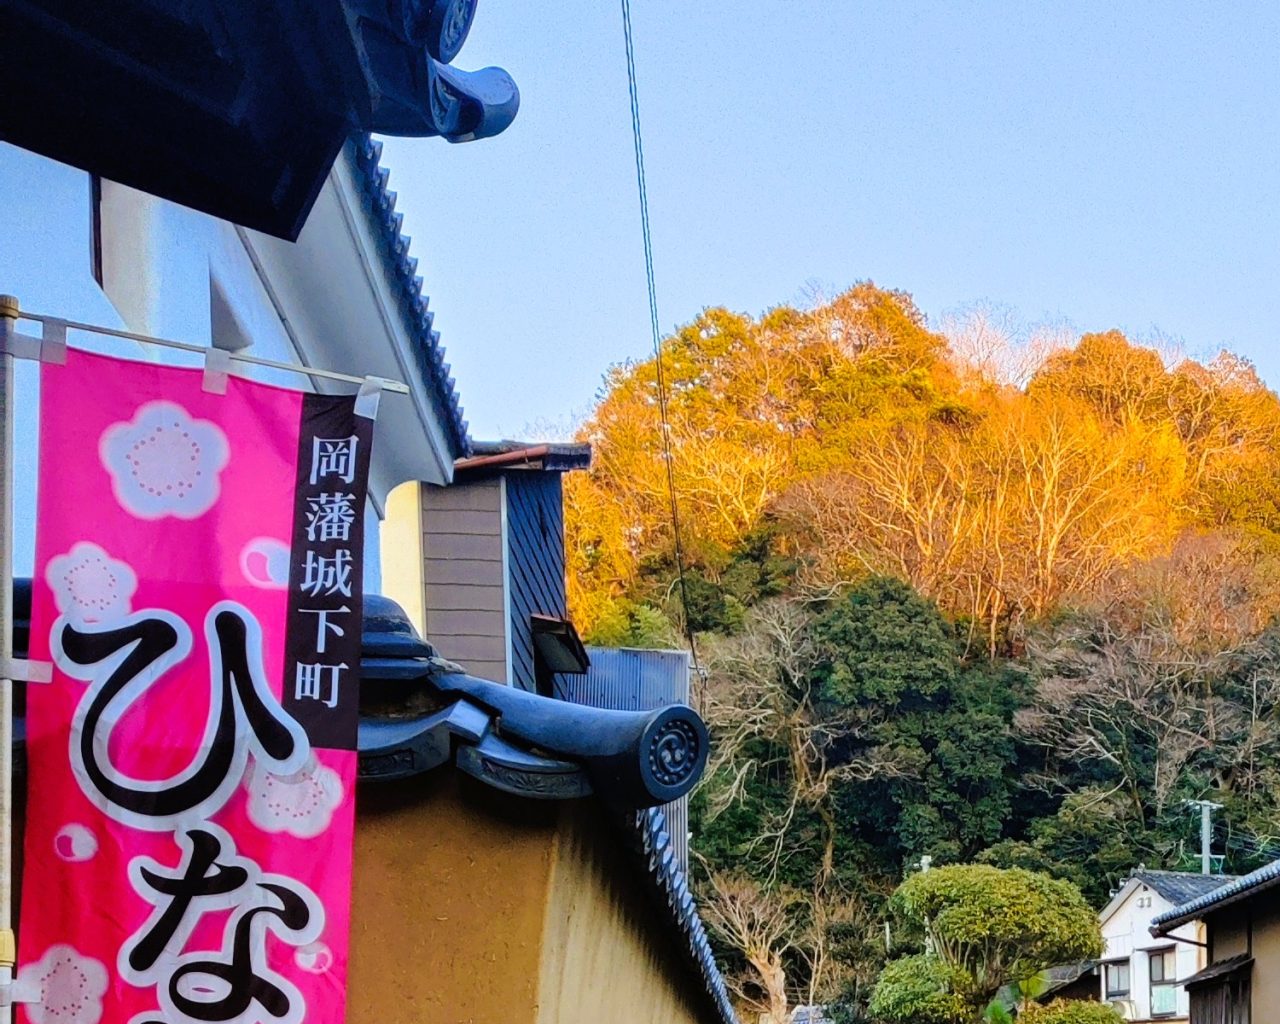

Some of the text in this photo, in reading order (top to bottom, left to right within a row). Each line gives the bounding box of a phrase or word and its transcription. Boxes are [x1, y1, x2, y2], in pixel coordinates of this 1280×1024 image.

[295, 434, 360, 709] 岡藩城下町
